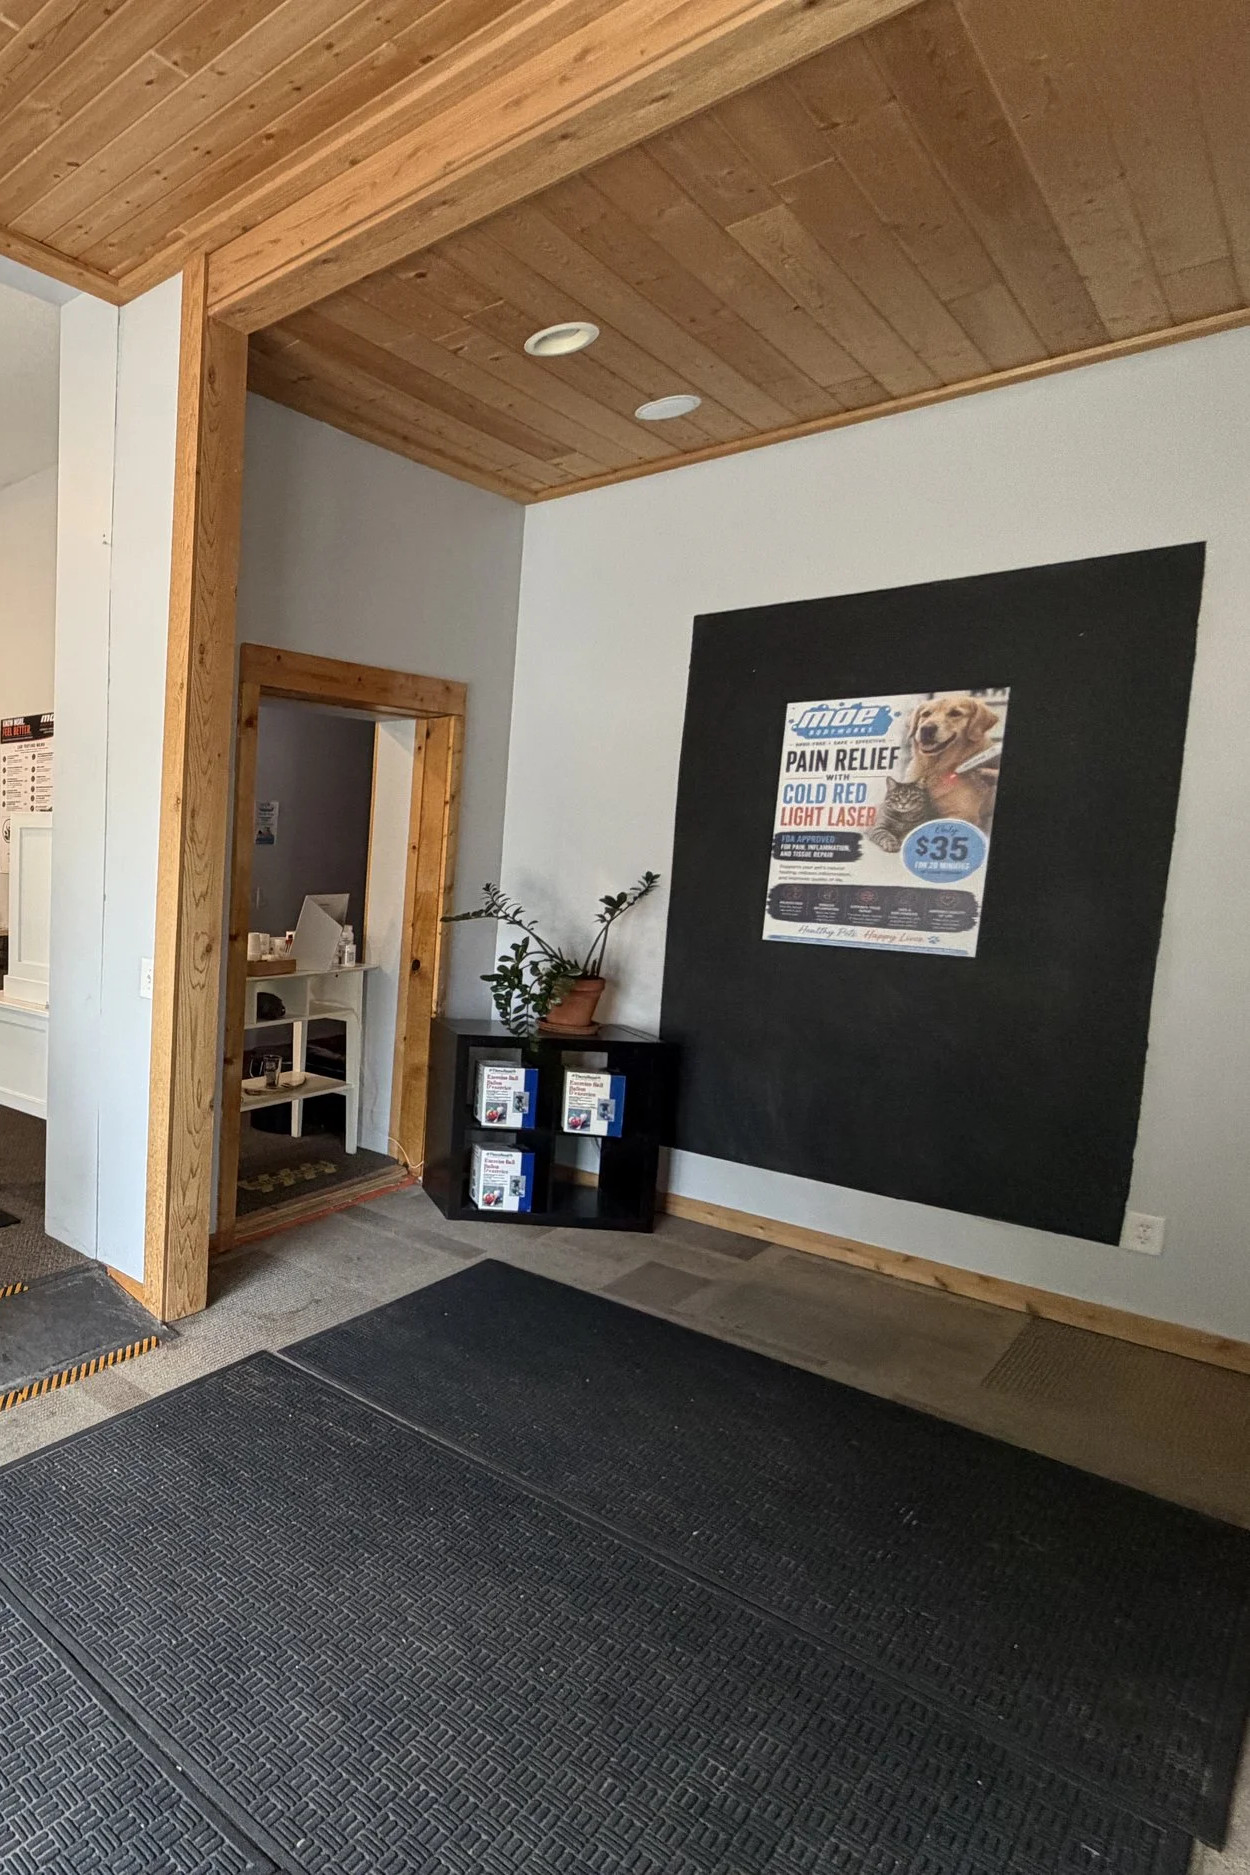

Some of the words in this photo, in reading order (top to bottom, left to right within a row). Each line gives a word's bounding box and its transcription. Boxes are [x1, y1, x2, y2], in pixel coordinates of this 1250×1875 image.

[40, 714, 54, 723] mo
[797, 707, 880, 729] moe
[785, 749, 829, 773] PAIN
[834, 746, 901, 771] RELIEF
[782, 783, 827, 804] COLD
[832, 783, 867, 804] RED
[780, 806, 825, 827] LIGHT
[827, 806, 877, 827] LASER
[797, 835, 835, 843] APPROVED
[915, 835, 969, 861] $35
[798, 924, 835, 938] Healthy
[863, 929, 896, 942] Happy
